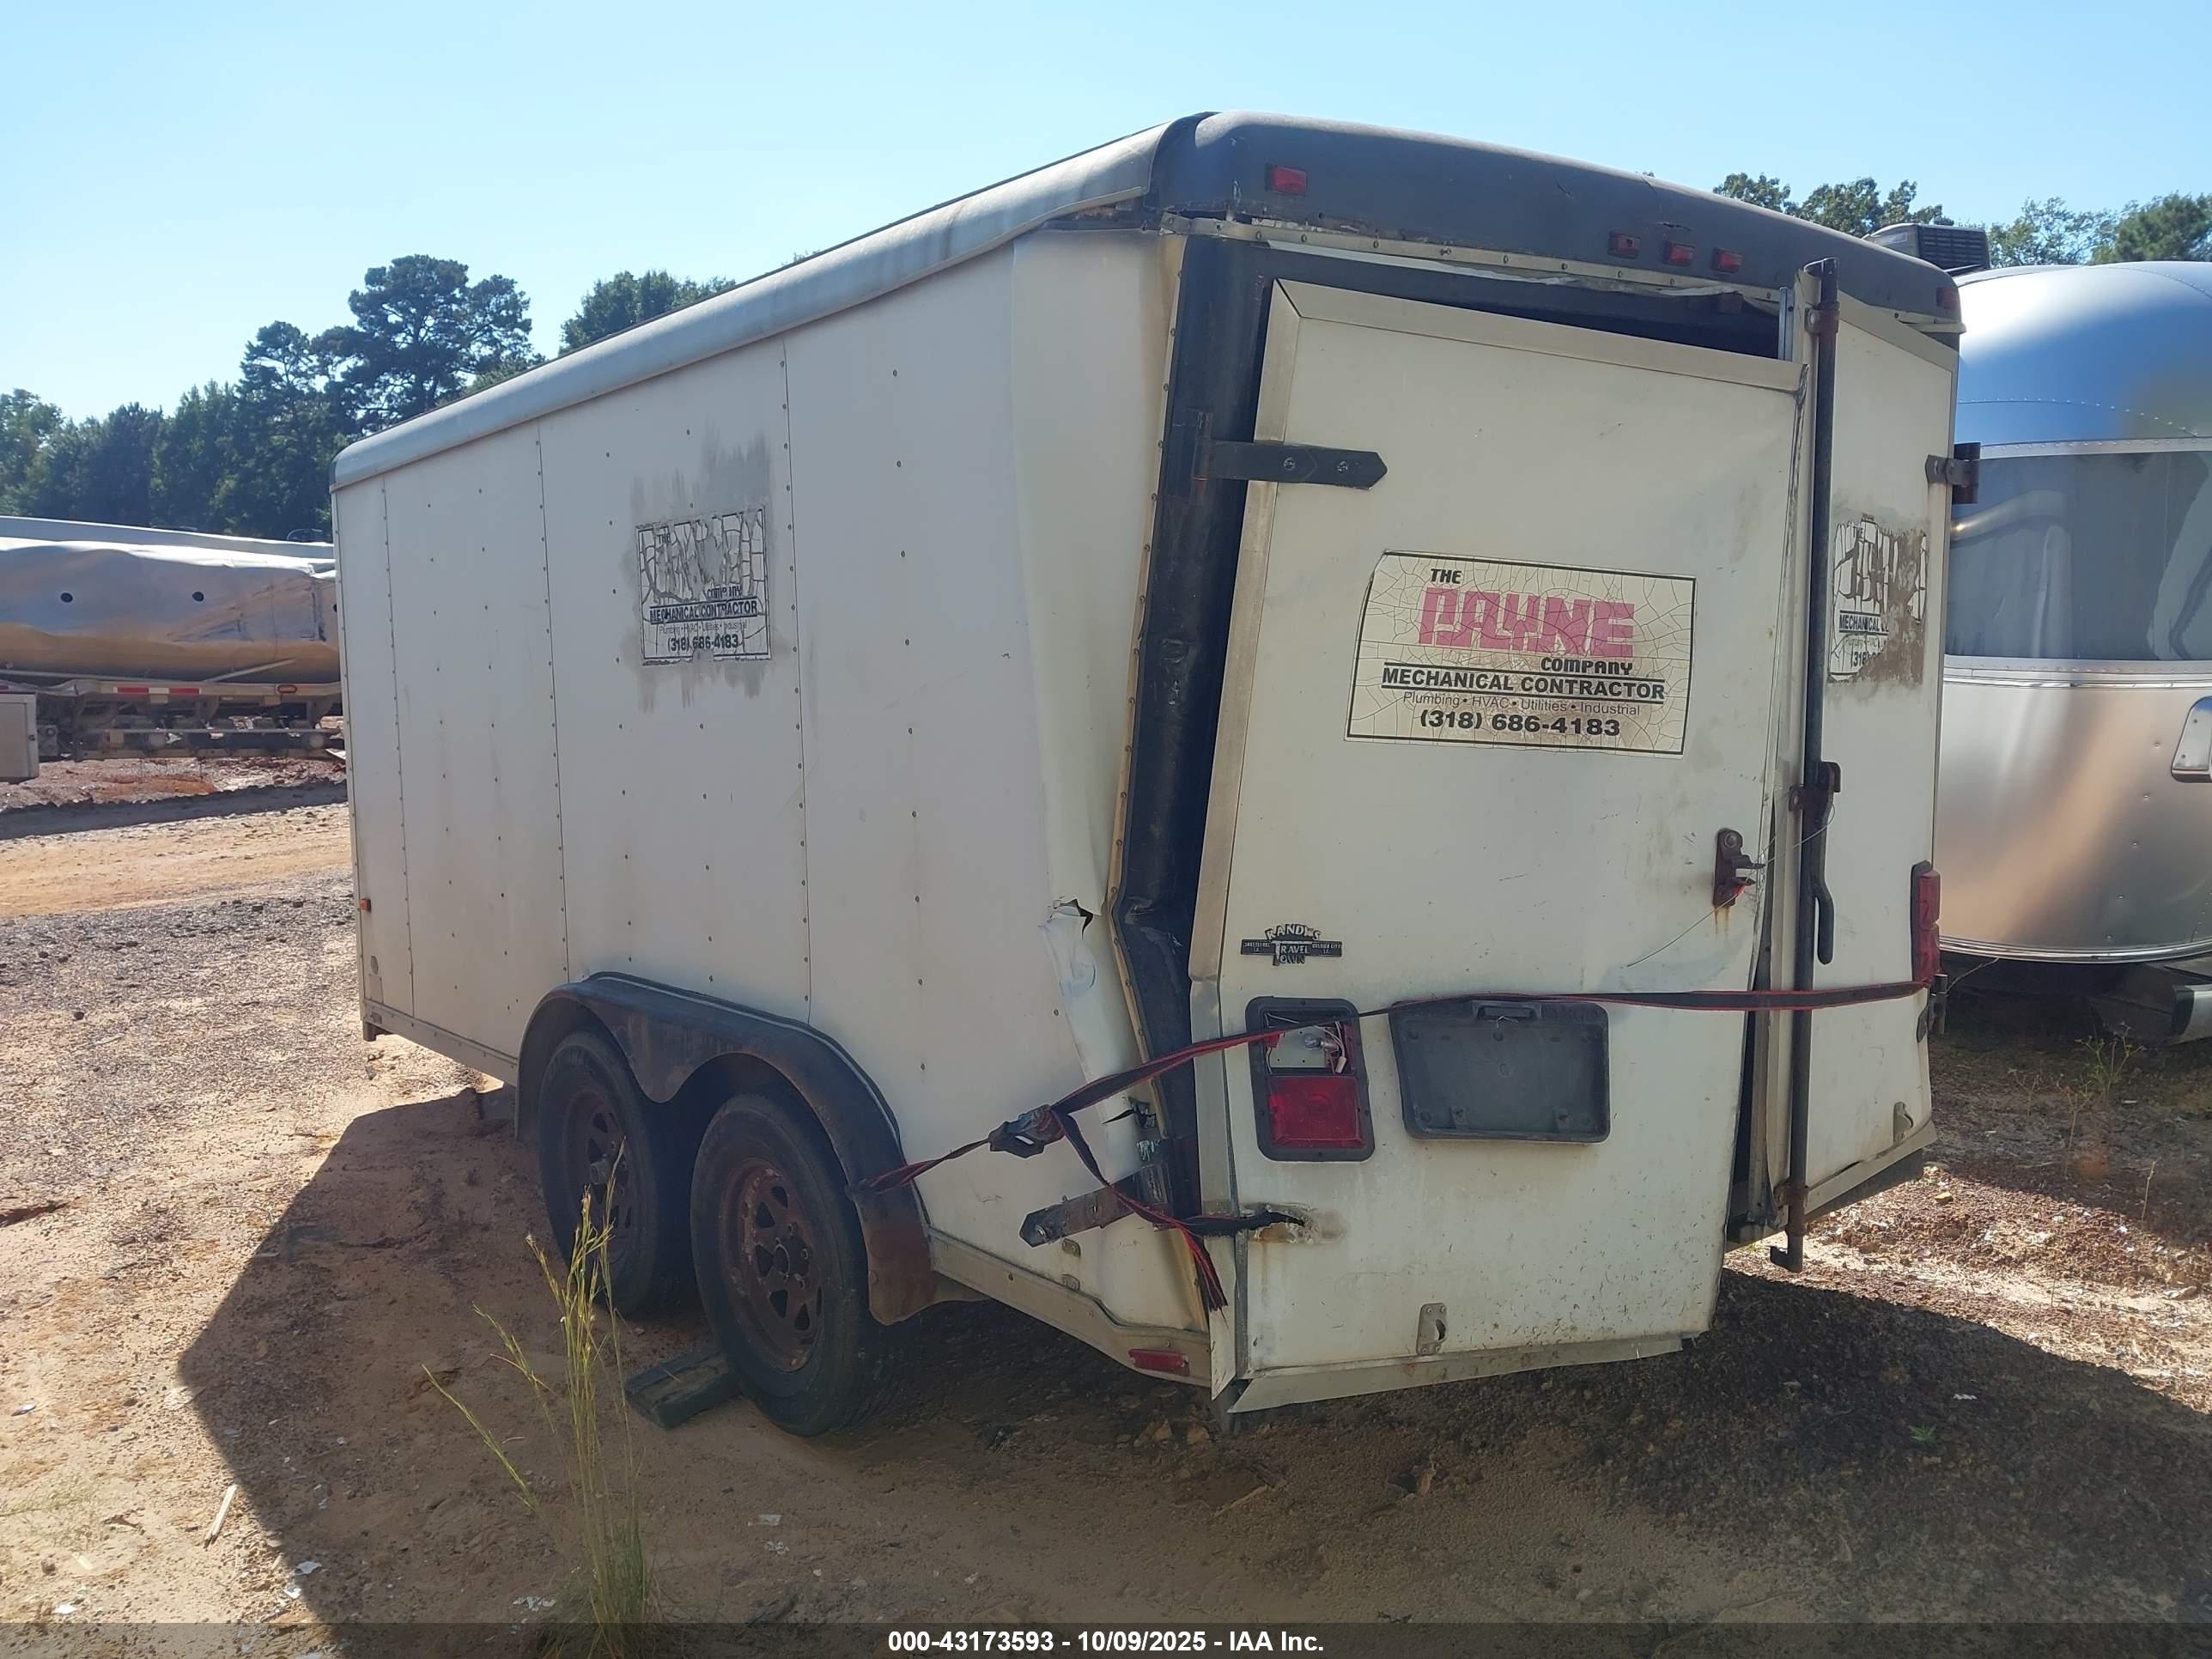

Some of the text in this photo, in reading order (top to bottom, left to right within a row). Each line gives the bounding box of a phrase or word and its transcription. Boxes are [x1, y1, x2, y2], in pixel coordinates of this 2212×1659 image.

[1430, 568, 1462, 584] THE
[650, 600, 757, 622] MECHANICAL CONTRACTOR
[1839, 613, 1880, 632] MECHANICAL
[1540, 657, 1633, 676] COMPANY
[1382, 665, 1665, 700] MECHANICAL CONTRACTOR
[1402, 691, 1640, 715] Plumbing HVAC Utilities Industrial
[1419, 709, 1620, 736] (318) 686-4183
